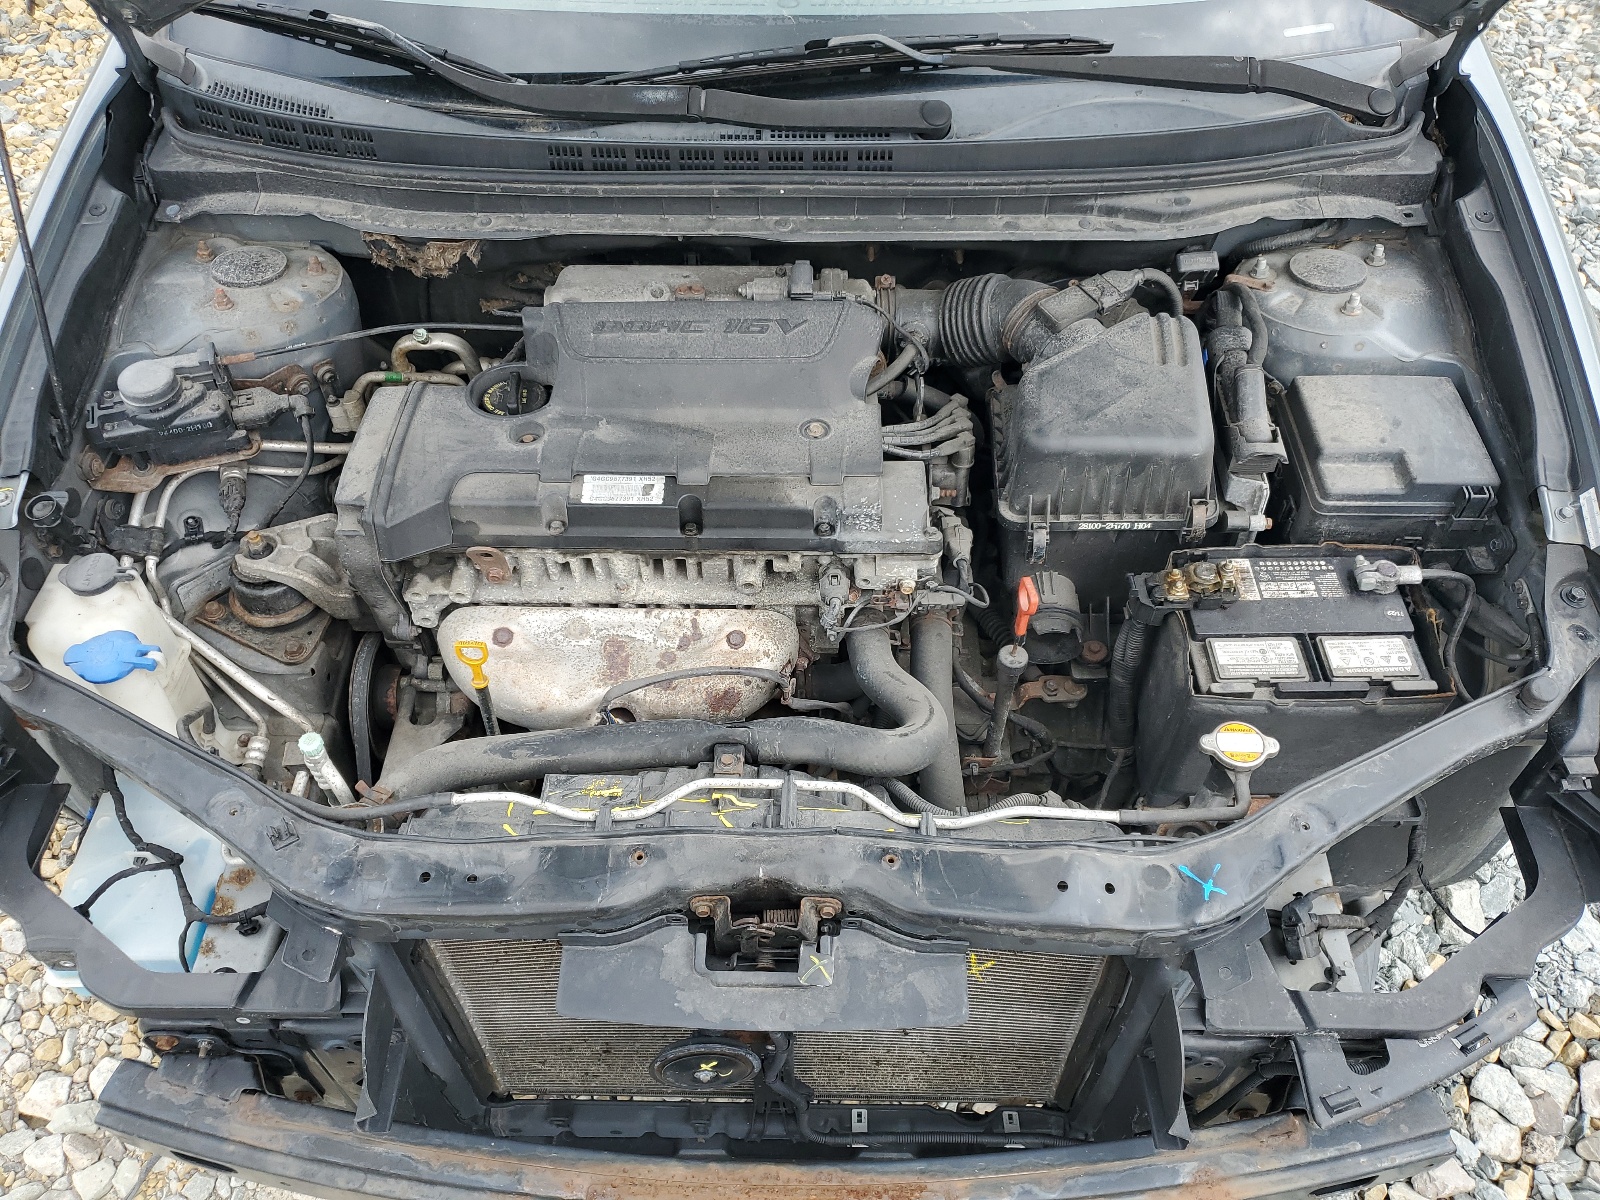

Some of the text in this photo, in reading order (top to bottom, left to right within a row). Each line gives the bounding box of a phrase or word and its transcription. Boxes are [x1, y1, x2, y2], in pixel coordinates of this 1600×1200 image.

[591, 318, 809, 335] DOHC 16V
[1077, 522, 1152, 530] 28100-2H770 H04
